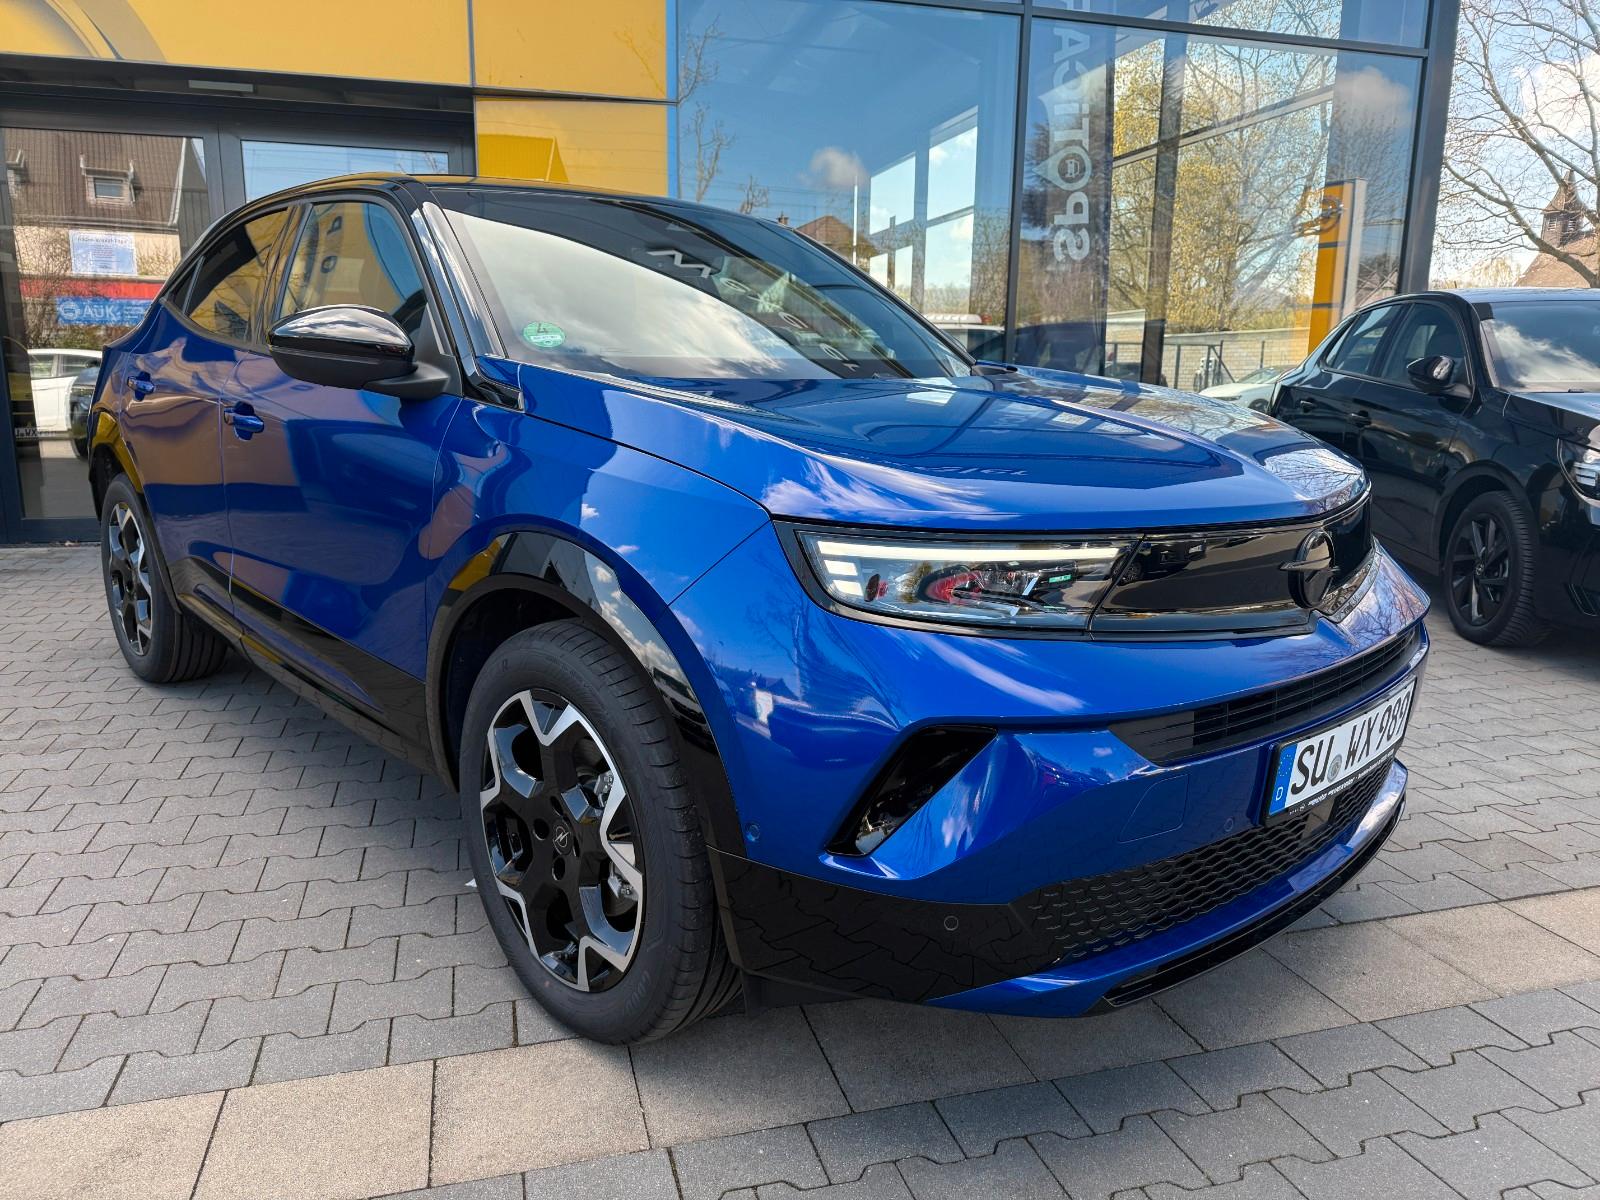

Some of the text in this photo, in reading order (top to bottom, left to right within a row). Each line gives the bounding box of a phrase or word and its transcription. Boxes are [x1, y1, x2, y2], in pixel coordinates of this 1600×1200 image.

[1275, 786, 1284, 801] D
[1290, 735, 1335, 795] SU
[1344, 711, 1380, 770] WX
[1375, 691, 1410, 751] 989
